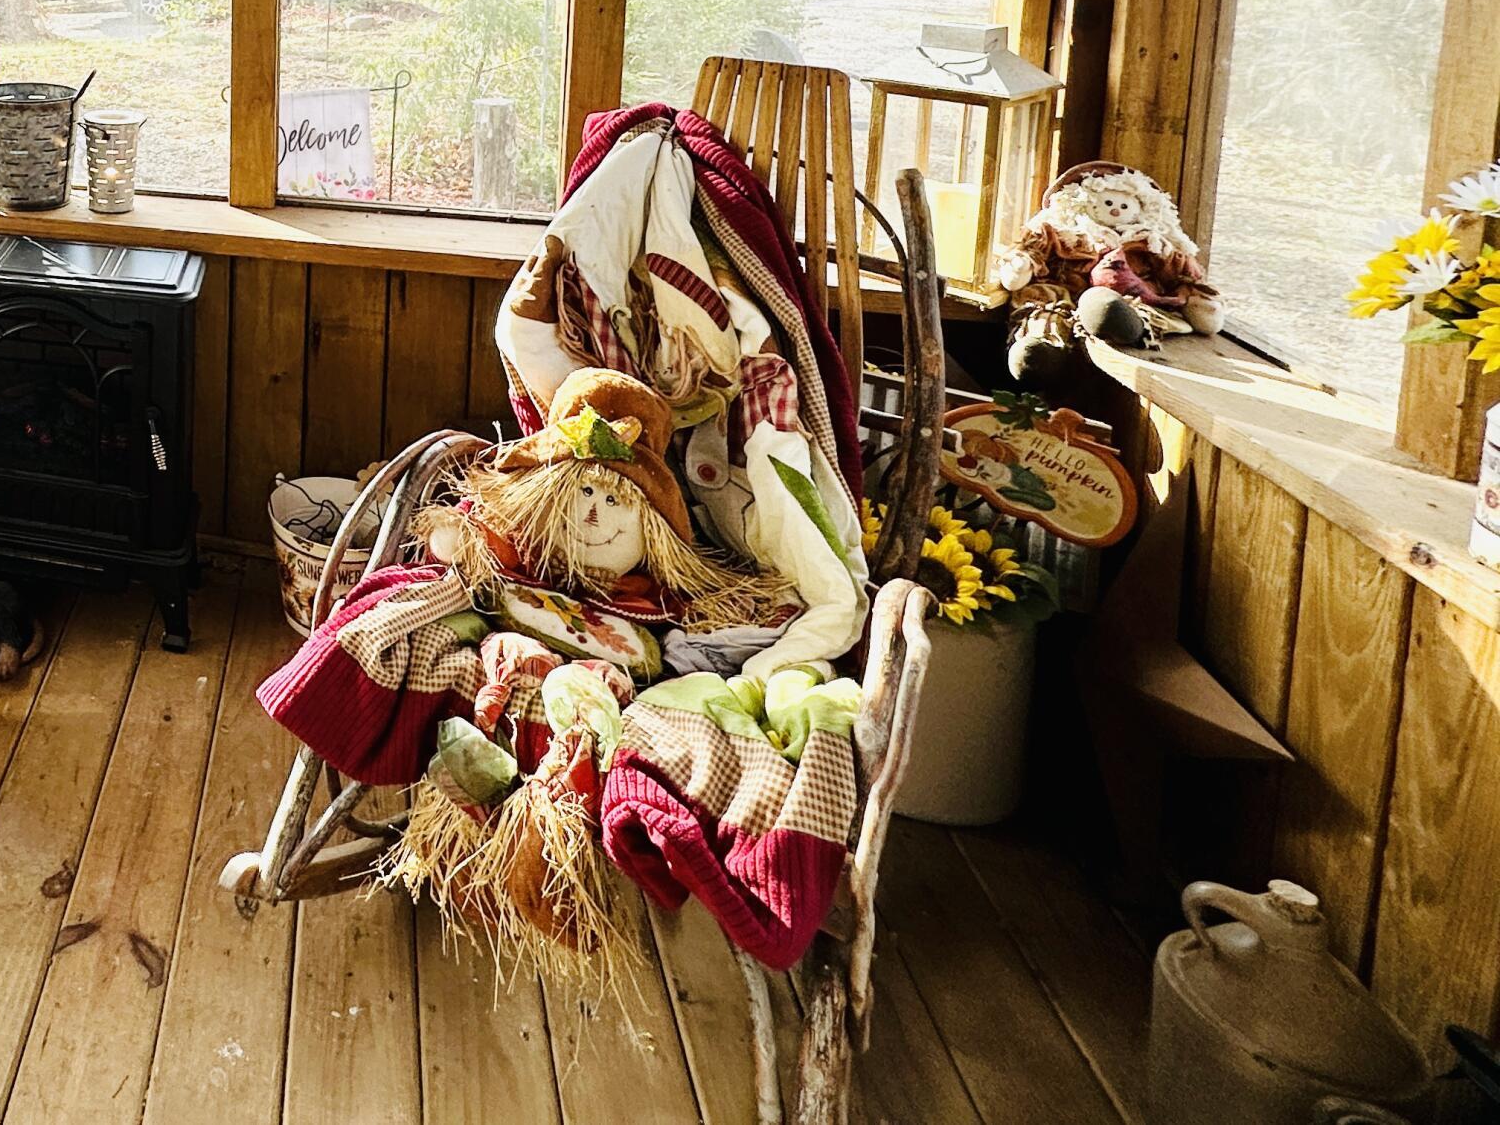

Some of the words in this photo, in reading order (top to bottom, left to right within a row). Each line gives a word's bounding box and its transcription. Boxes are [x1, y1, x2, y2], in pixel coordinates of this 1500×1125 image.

[277, 118, 363, 166] elcome
[1024, 449, 1115, 499] pumpkin
[1030, 436, 1086, 471] HELLO
[296, 558, 363, 586] SUNFWER
